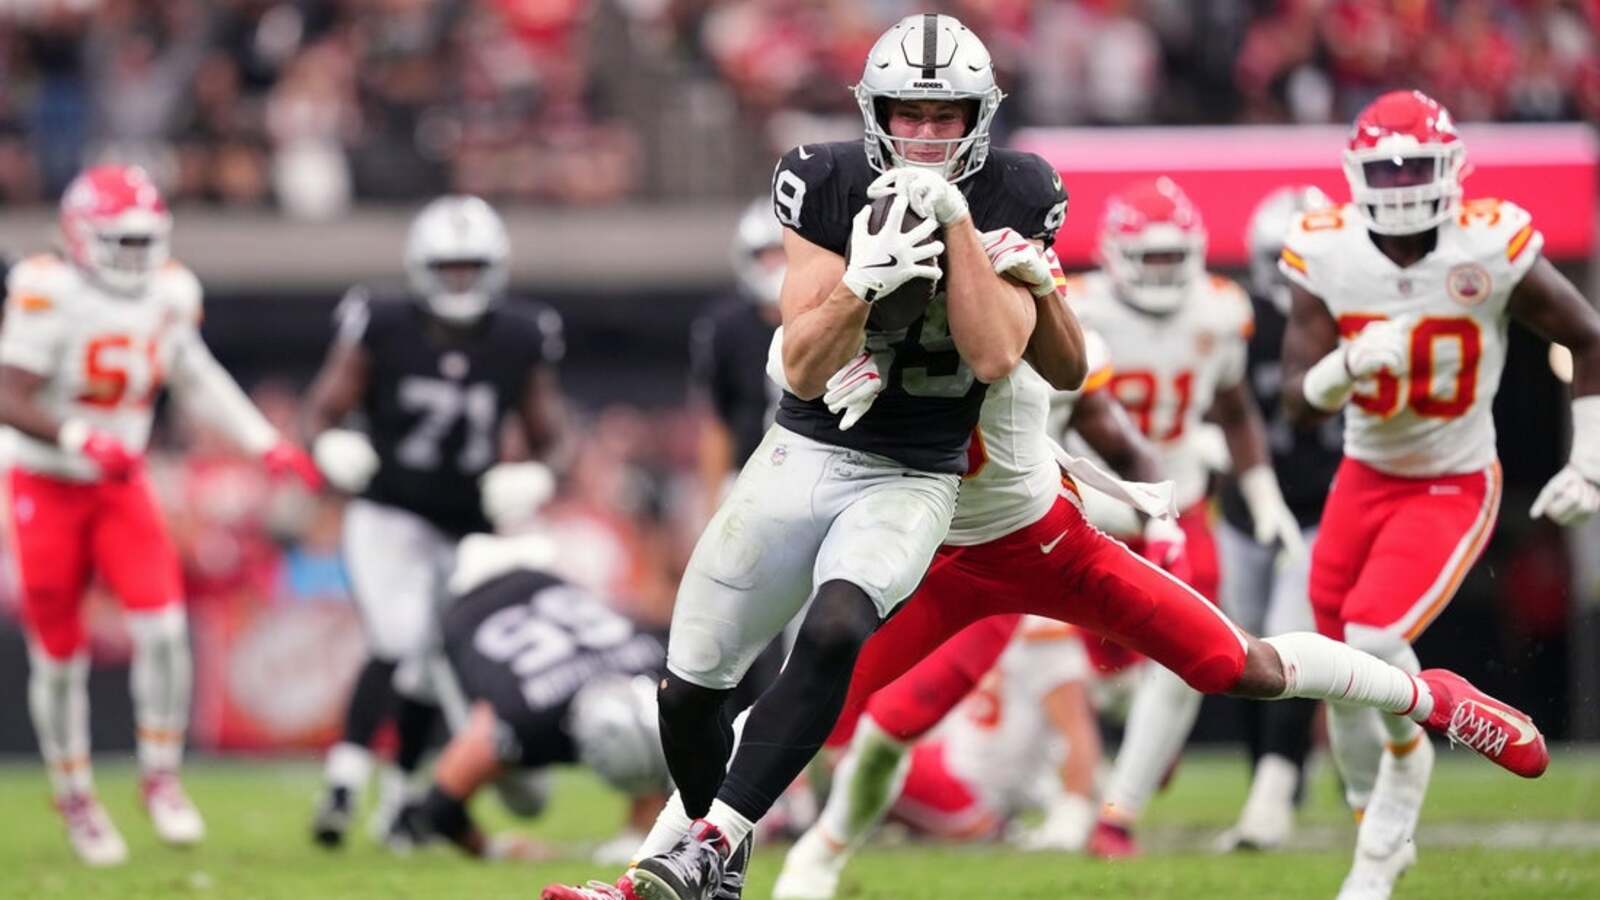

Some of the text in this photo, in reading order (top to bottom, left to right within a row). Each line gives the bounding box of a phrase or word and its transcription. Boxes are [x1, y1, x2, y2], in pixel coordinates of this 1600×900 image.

[913, 81, 944, 89] RAIDERS
[771, 157, 807, 229] 9
[397, 373, 499, 473] 71
[1106, 369, 1194, 444] 91
